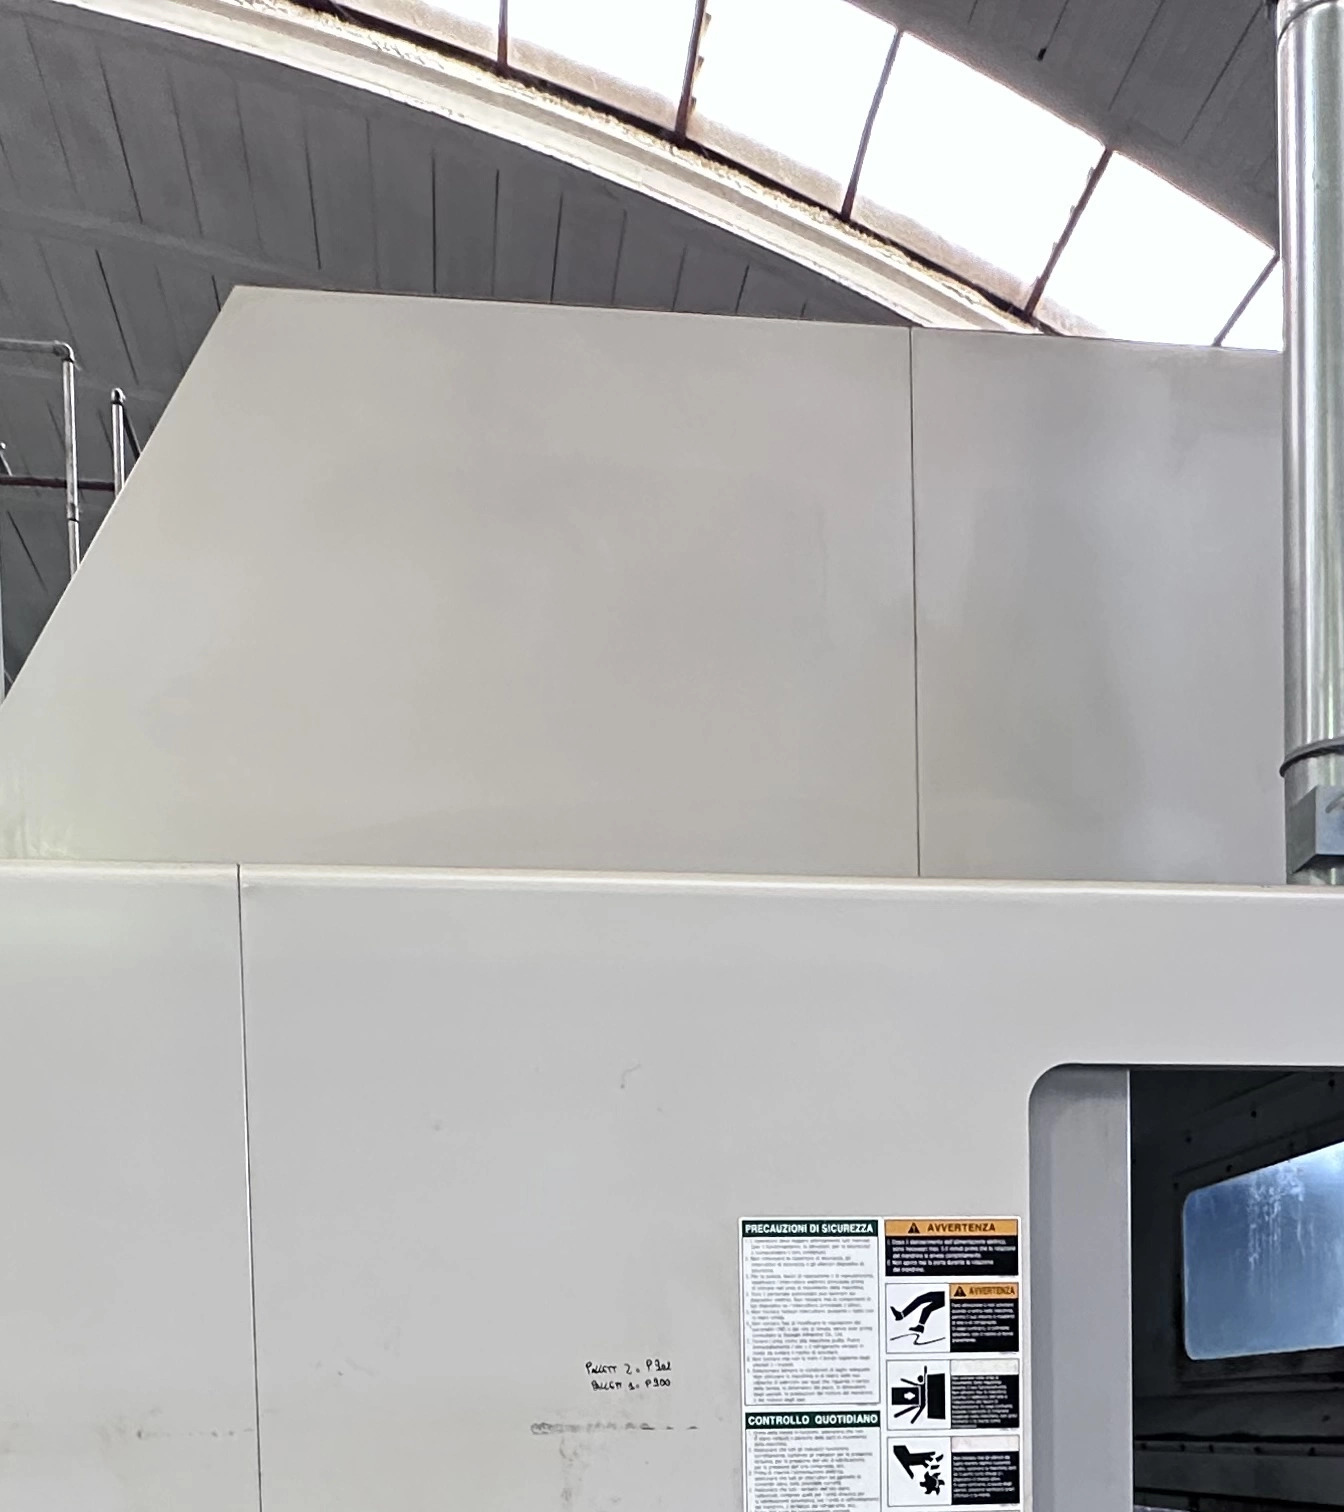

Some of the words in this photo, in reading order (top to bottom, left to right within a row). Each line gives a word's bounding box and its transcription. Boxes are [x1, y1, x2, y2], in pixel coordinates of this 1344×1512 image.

[745, 1223, 807, 1234] PRECAUZIONI
[809, 1223, 820, 1233] DI
[822, 1223, 874, 1233] SICUREZZA
[927, 1223, 996, 1232] AVVERTENZA
[748, 1415, 810, 1426] CONTROLLO
[814, 1413, 878, 1425] QUOTIDIANO
